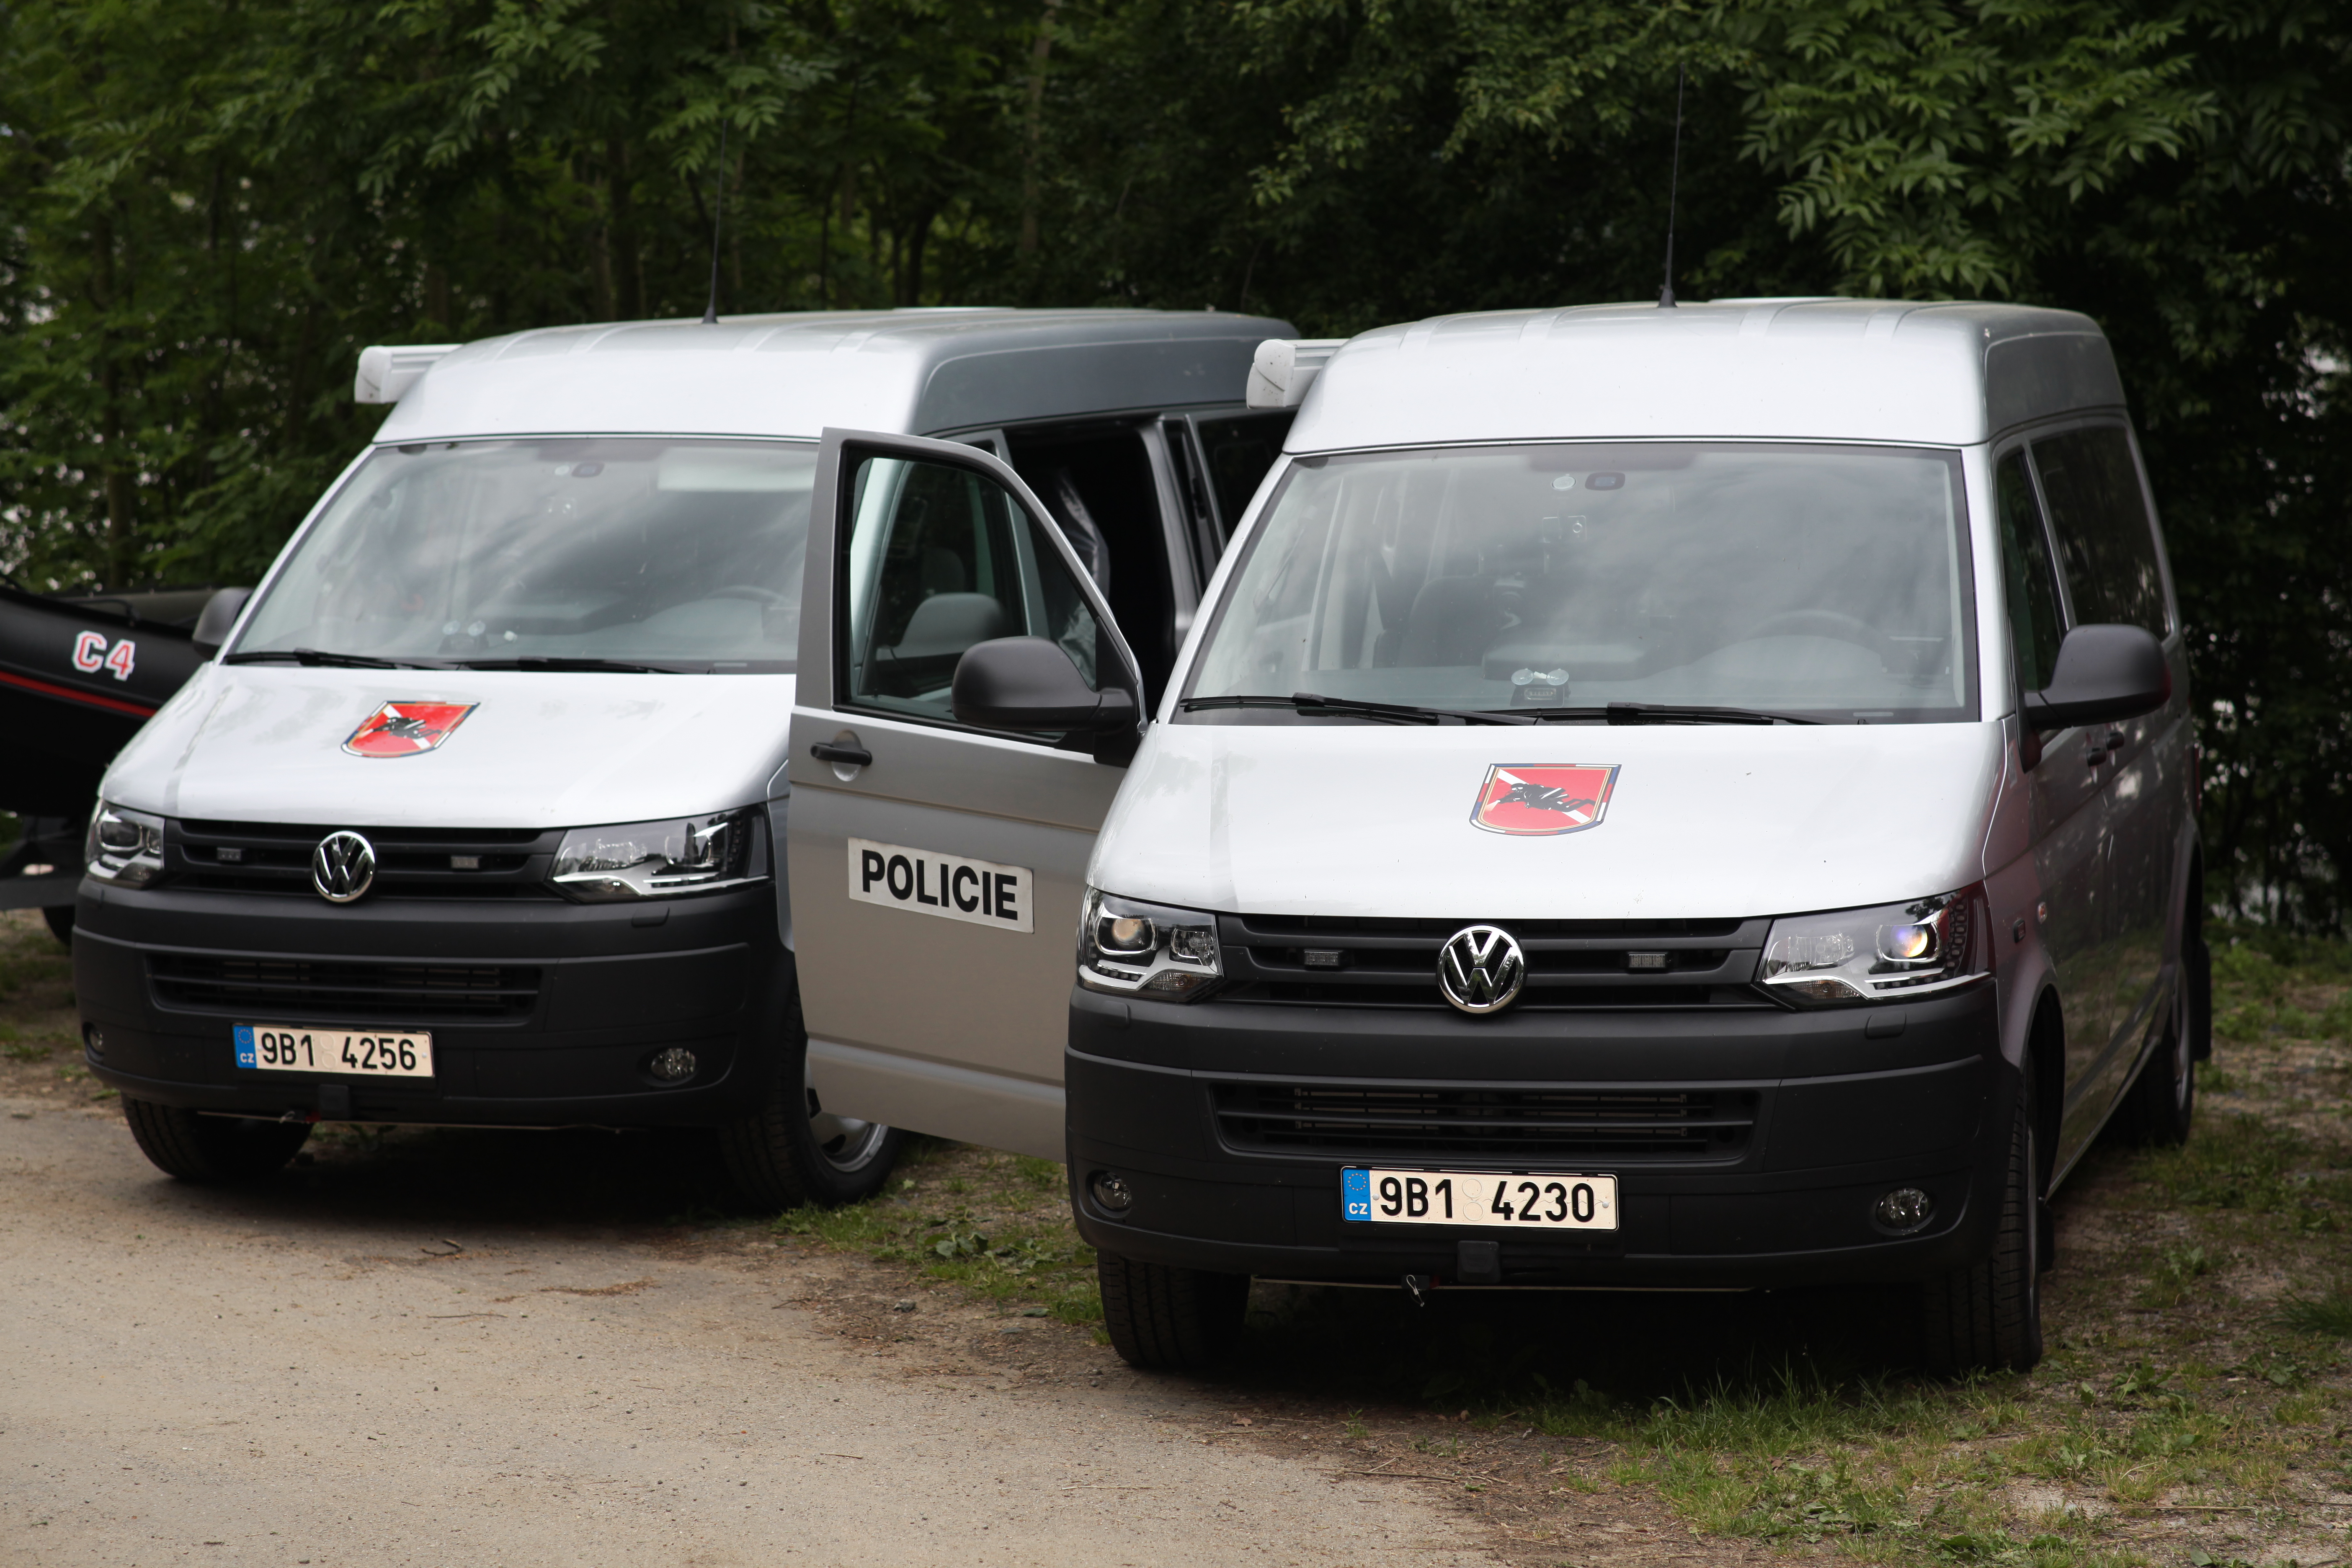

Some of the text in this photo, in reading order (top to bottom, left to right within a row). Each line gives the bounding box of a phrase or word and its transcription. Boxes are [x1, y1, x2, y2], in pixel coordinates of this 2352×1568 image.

[72, 630, 136, 682] C4
[862, 849, 1018, 921] POLICIE
[240, 1052, 255, 1064] CZ
[261, 1032, 416, 1070] 9B1 4256
[1349, 1202, 1368, 1215] CZ
[1380, 1176, 1595, 1223] 9B1 4230
